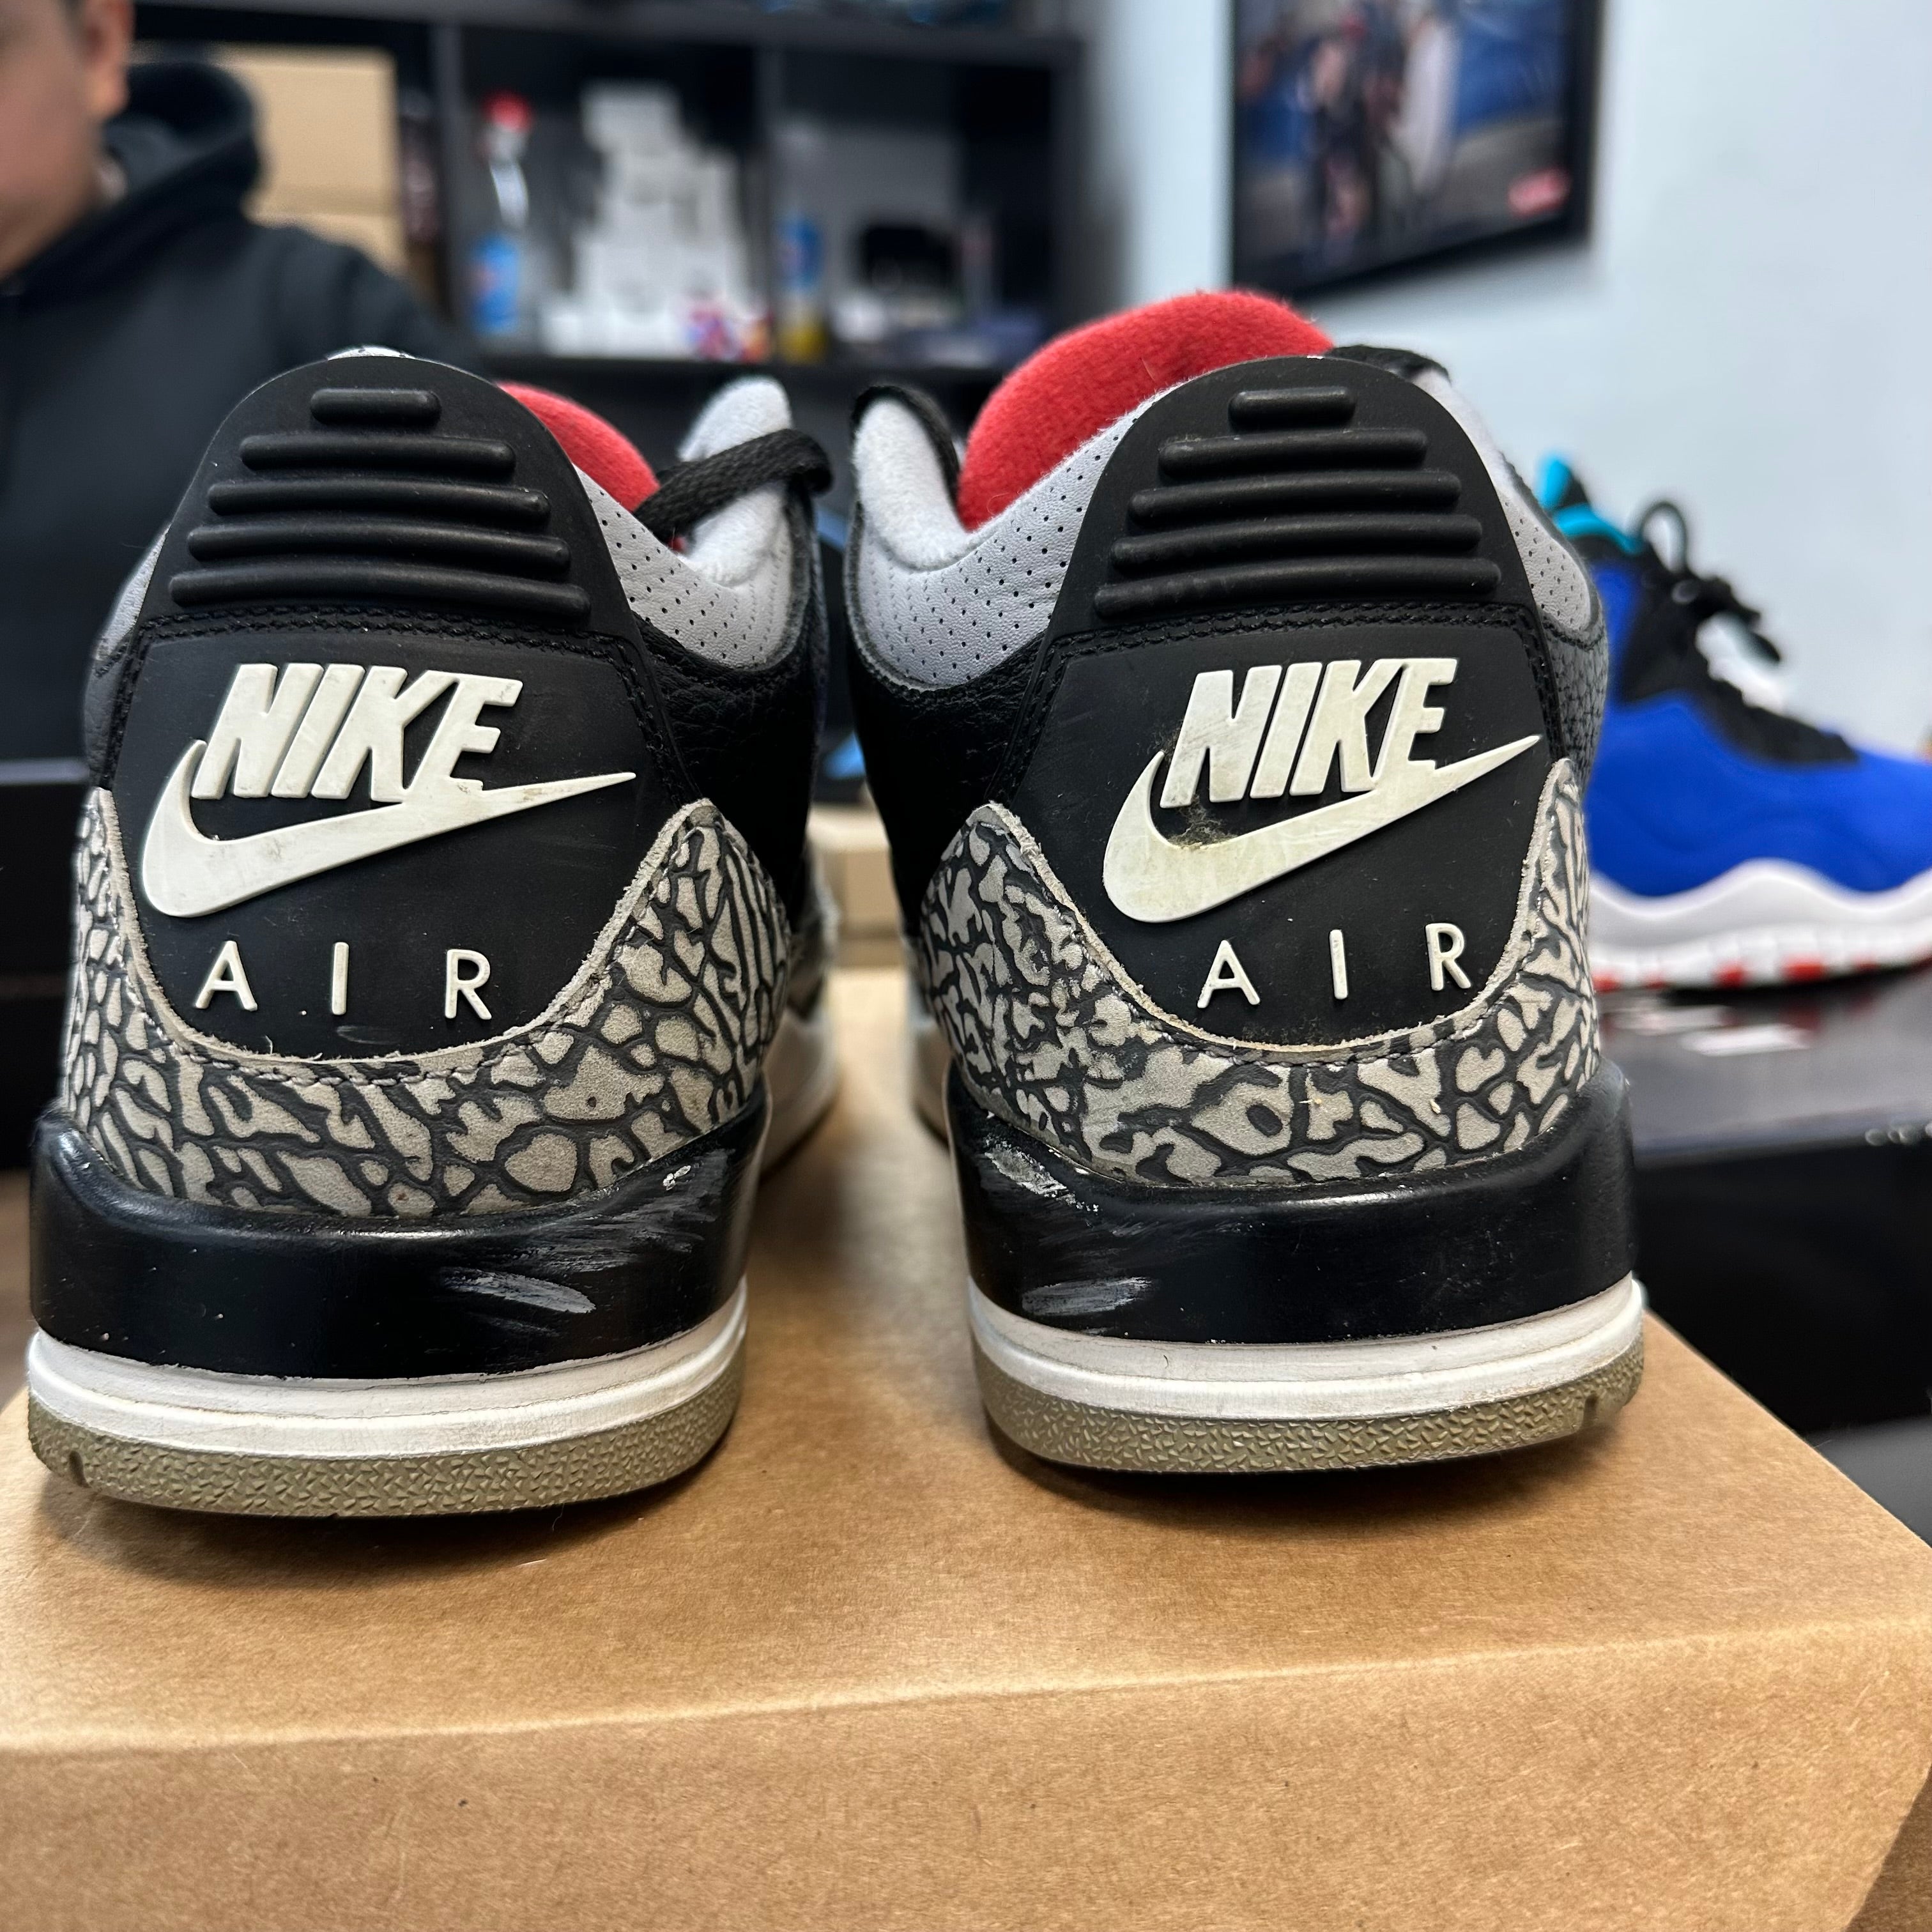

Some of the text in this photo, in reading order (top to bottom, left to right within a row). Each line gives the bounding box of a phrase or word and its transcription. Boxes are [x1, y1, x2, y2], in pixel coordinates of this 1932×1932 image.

[190, 663, 524, 802] NIKE
[1159, 657, 1458, 809] NIKE
[194, 940, 493, 1020] AIR
[1197, 923, 1471, 1008] AIR
